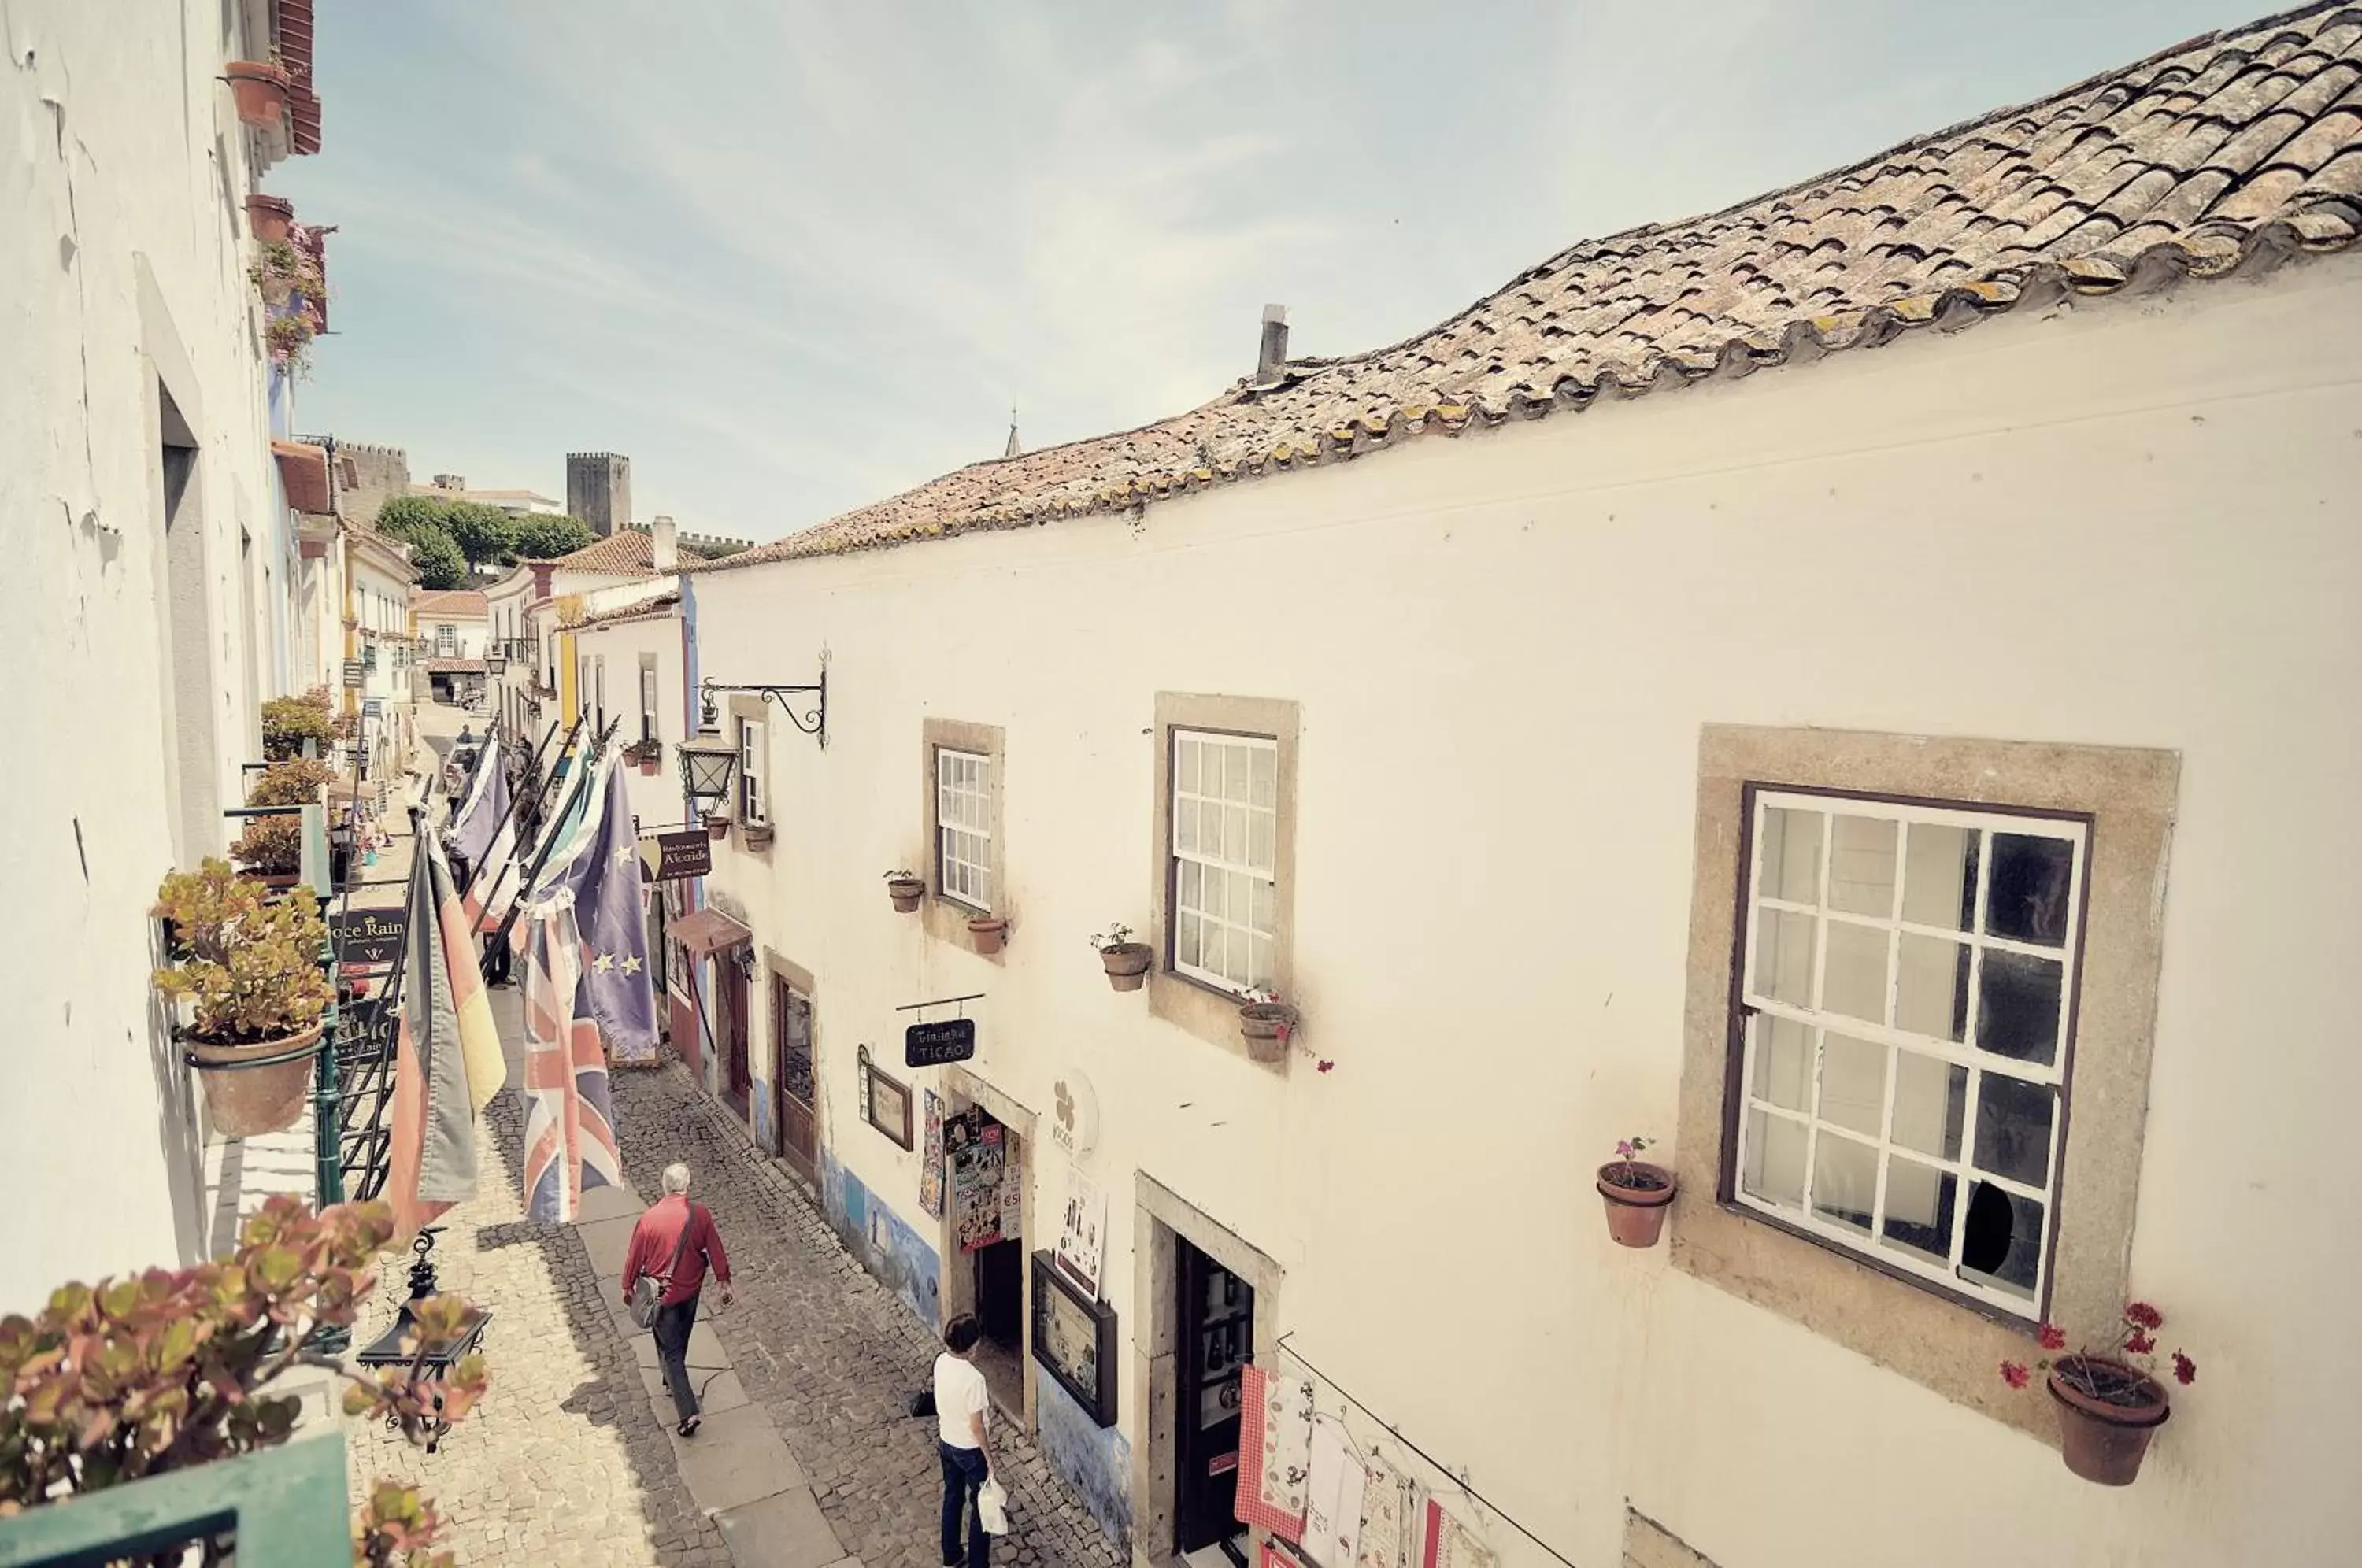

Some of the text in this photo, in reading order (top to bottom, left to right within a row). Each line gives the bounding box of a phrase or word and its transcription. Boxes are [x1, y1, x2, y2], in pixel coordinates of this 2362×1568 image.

[665, 849, 708, 864] Alcaide
[331, 922, 403, 939] oce Rain
